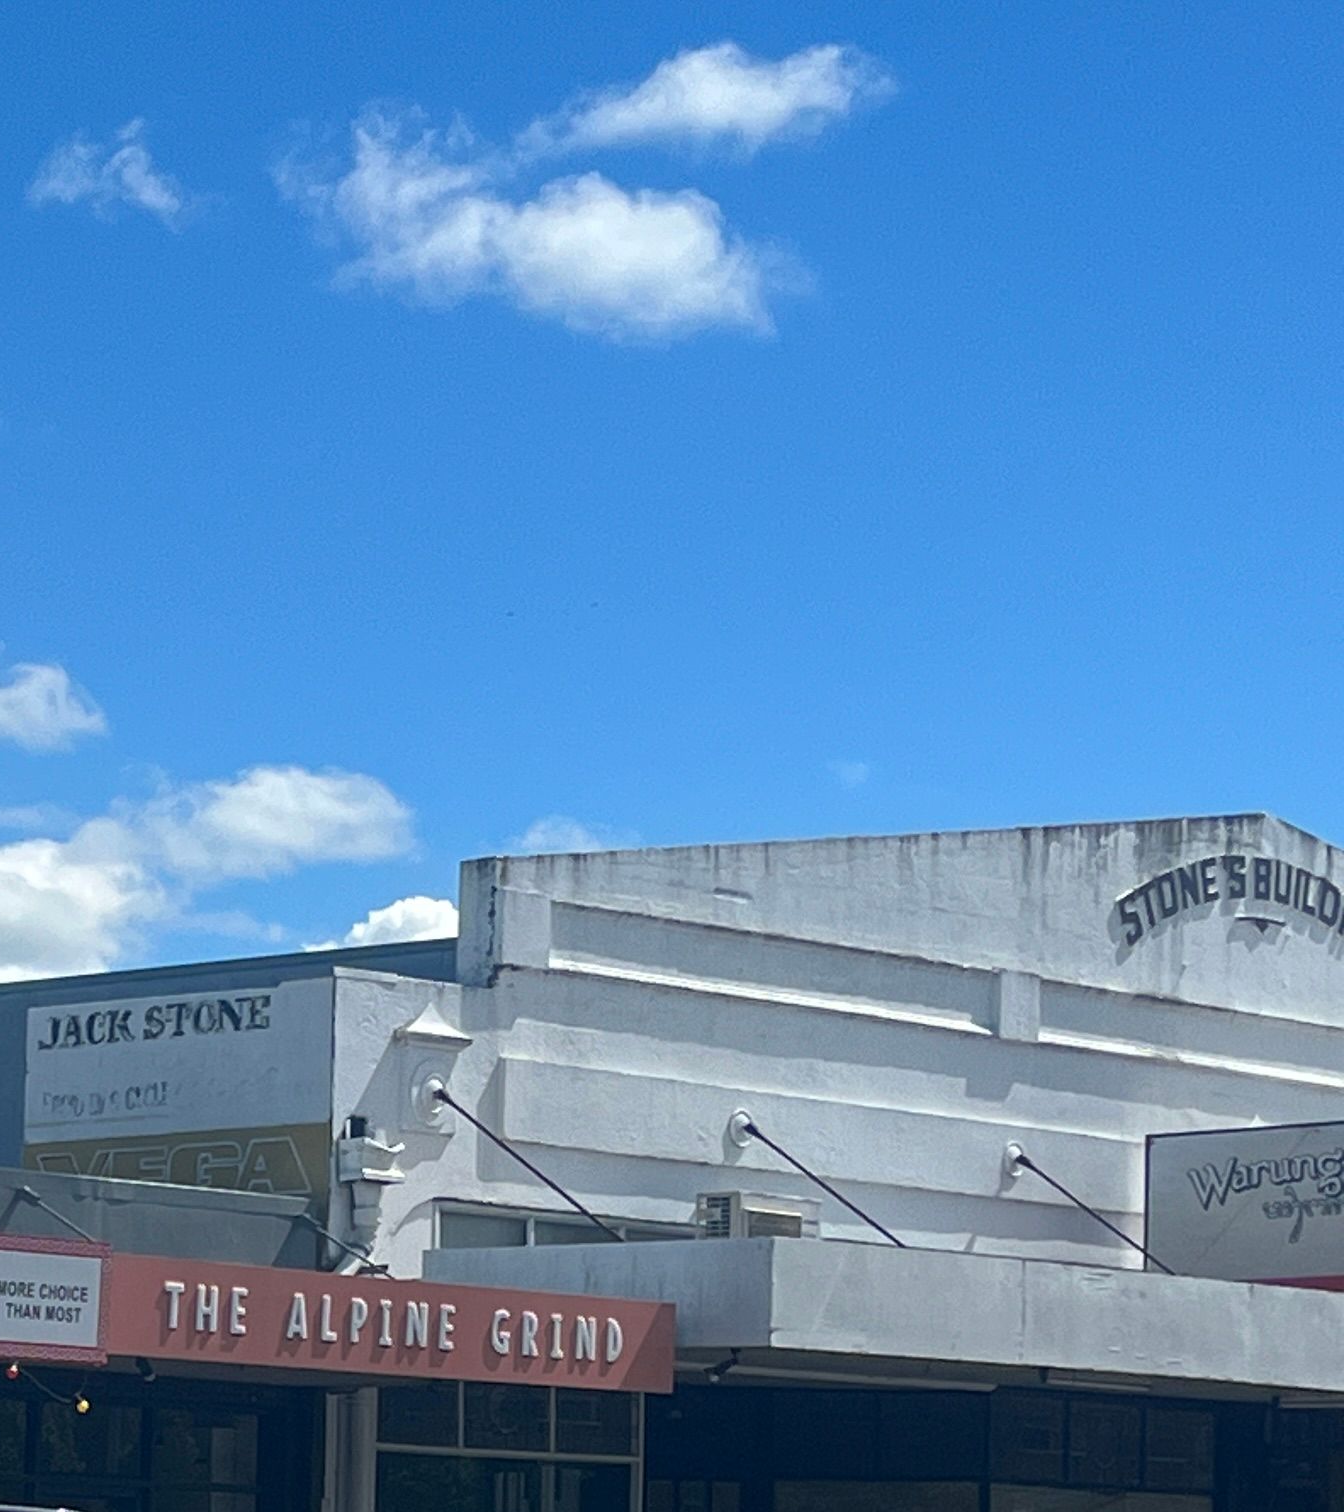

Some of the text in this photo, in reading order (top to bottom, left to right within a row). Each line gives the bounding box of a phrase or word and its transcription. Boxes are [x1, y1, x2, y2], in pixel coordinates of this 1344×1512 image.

[38, 995, 271, 1050] JACK STONE
[1188, 1147, 1344, 1211] Warung
[6, 1302, 82, 1323] THAN MOST
[39, 1284, 88, 1302] CHOICE
[164, 1280, 624, 1364] THE ALPINE GRIND
